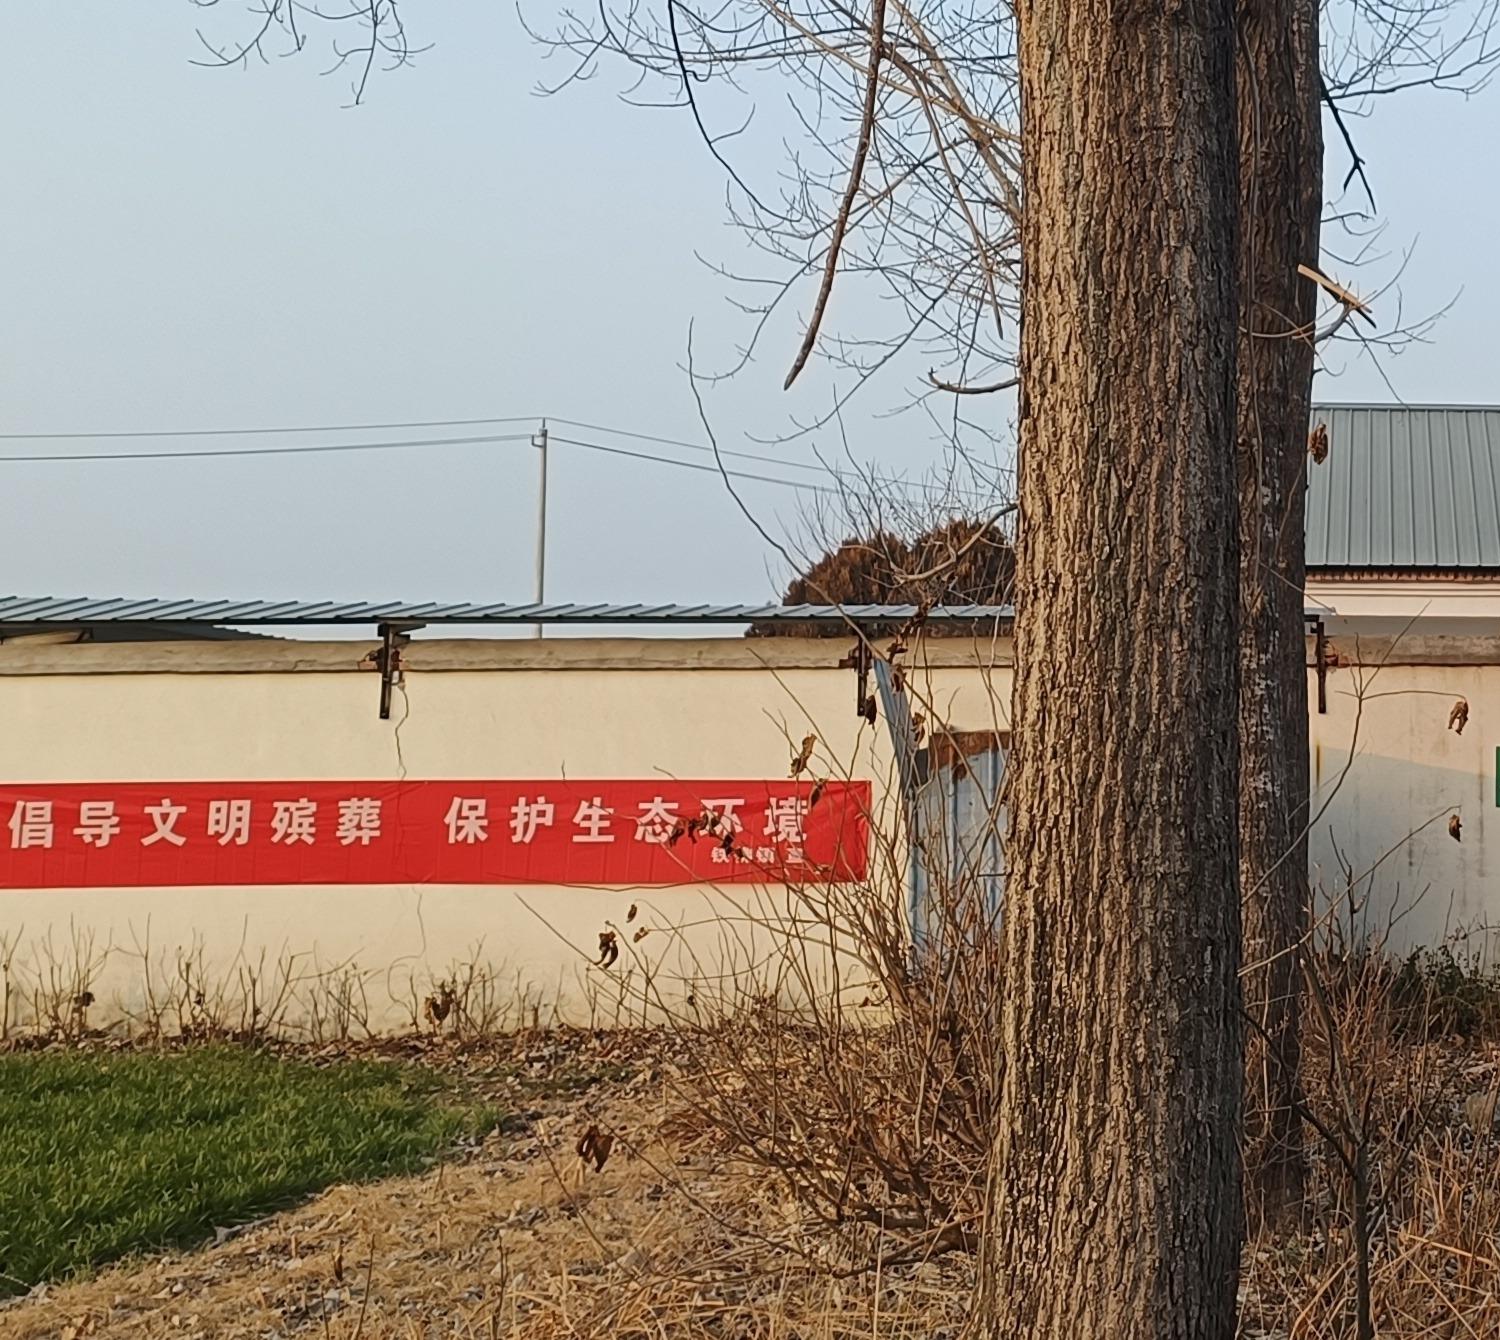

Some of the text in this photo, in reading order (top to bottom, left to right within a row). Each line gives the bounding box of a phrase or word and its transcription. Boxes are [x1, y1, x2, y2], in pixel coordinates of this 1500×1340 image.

[8, 795, 808, 849] 倡导文明殡葬 保护生态环境
